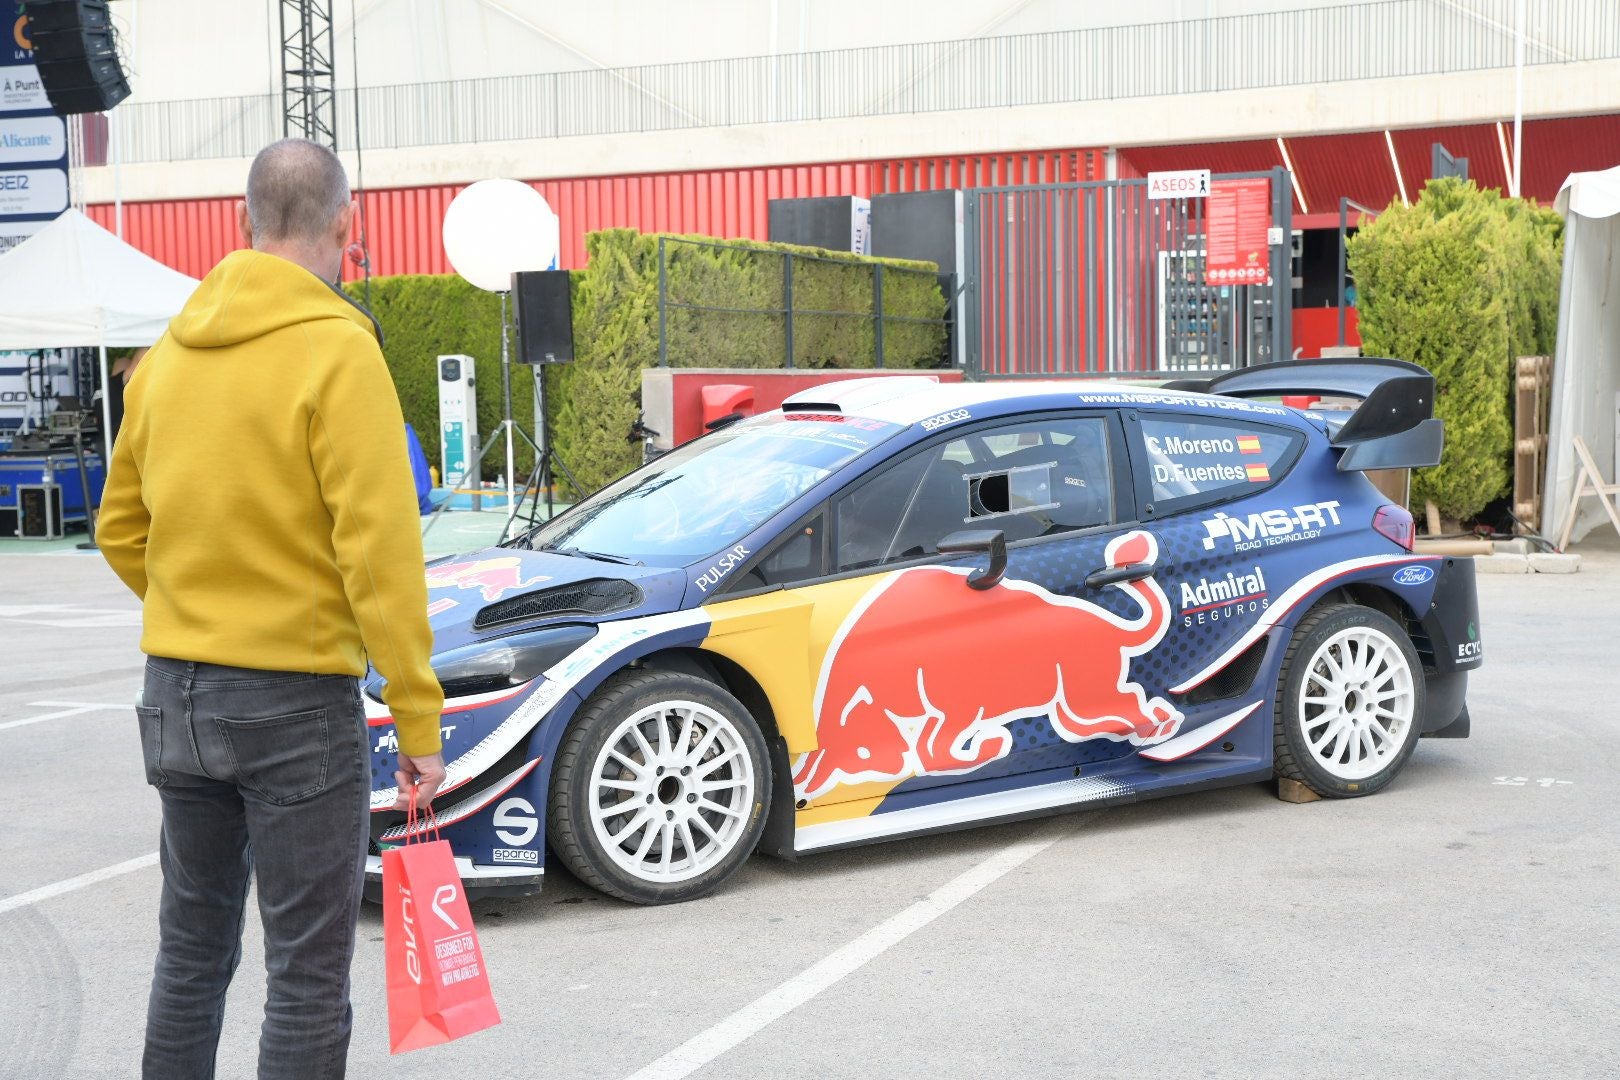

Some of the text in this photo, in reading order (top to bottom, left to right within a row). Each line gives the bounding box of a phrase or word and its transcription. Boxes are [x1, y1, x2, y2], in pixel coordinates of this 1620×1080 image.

[15, 80, 40, 91] Punt
[0, 134, 52, 148] Alicante
[1152, 178, 1196, 192] ASEOS
[921, 409, 971, 431] sparco
[1148, 436, 1234, 455] C.Moreno
[1154, 463, 1245, 482] D.Fuentes
[1223, 500, 1341, 543] MS-RT
[1235, 529, 1322, 552] ROAD TECHNOLOGY
[695, 545, 750, 592] PULSAR
[1180, 566, 1266, 609] Admiral
[1184, 599, 1269, 627] SEGUROS
[494, 849, 537, 862] sparco
[434, 936, 475, 960] DESIGNED FOR
